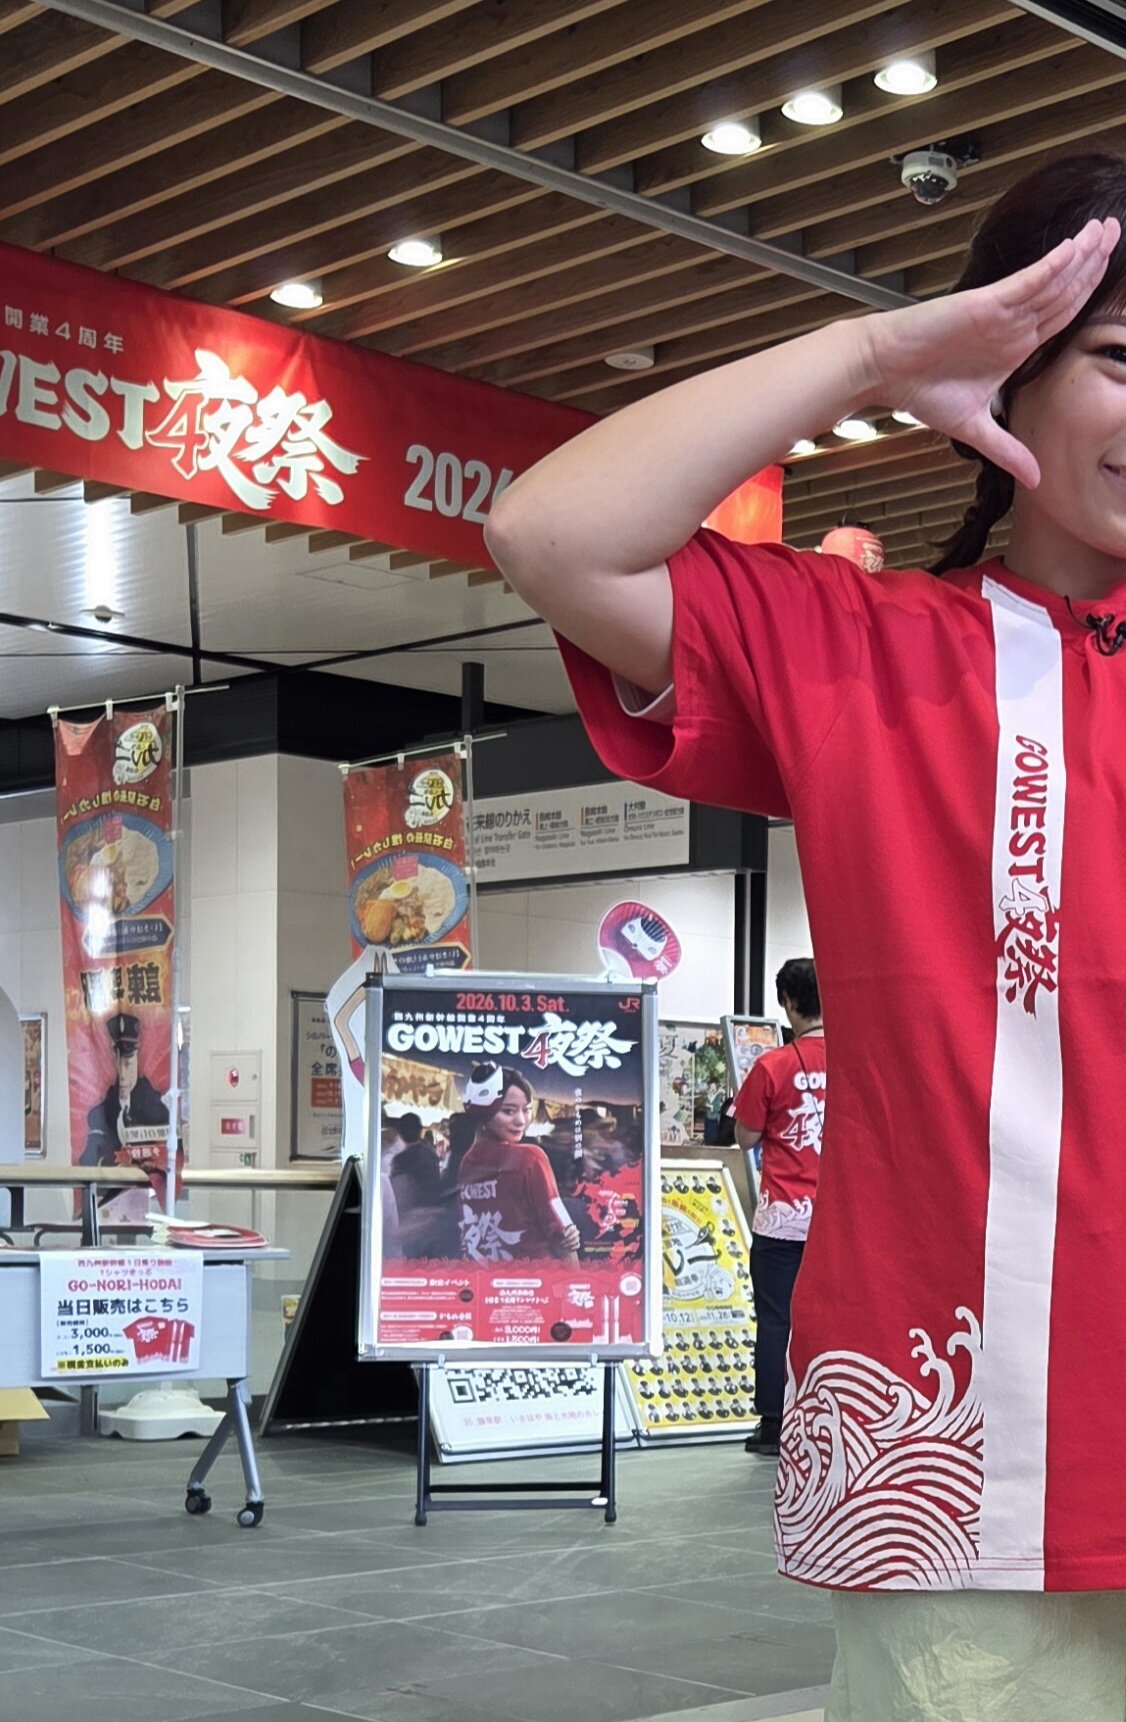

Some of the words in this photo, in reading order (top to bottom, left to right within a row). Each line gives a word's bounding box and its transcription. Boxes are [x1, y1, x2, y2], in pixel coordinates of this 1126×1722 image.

[466, 807, 531, 832] 来線のりかえ
[311, 1061, 342, 1077] 全席
[67, 1278, 182, 1292] GO-NORI-HODAI
[57, 1297, 189, 1316] 当日販売はこちら
